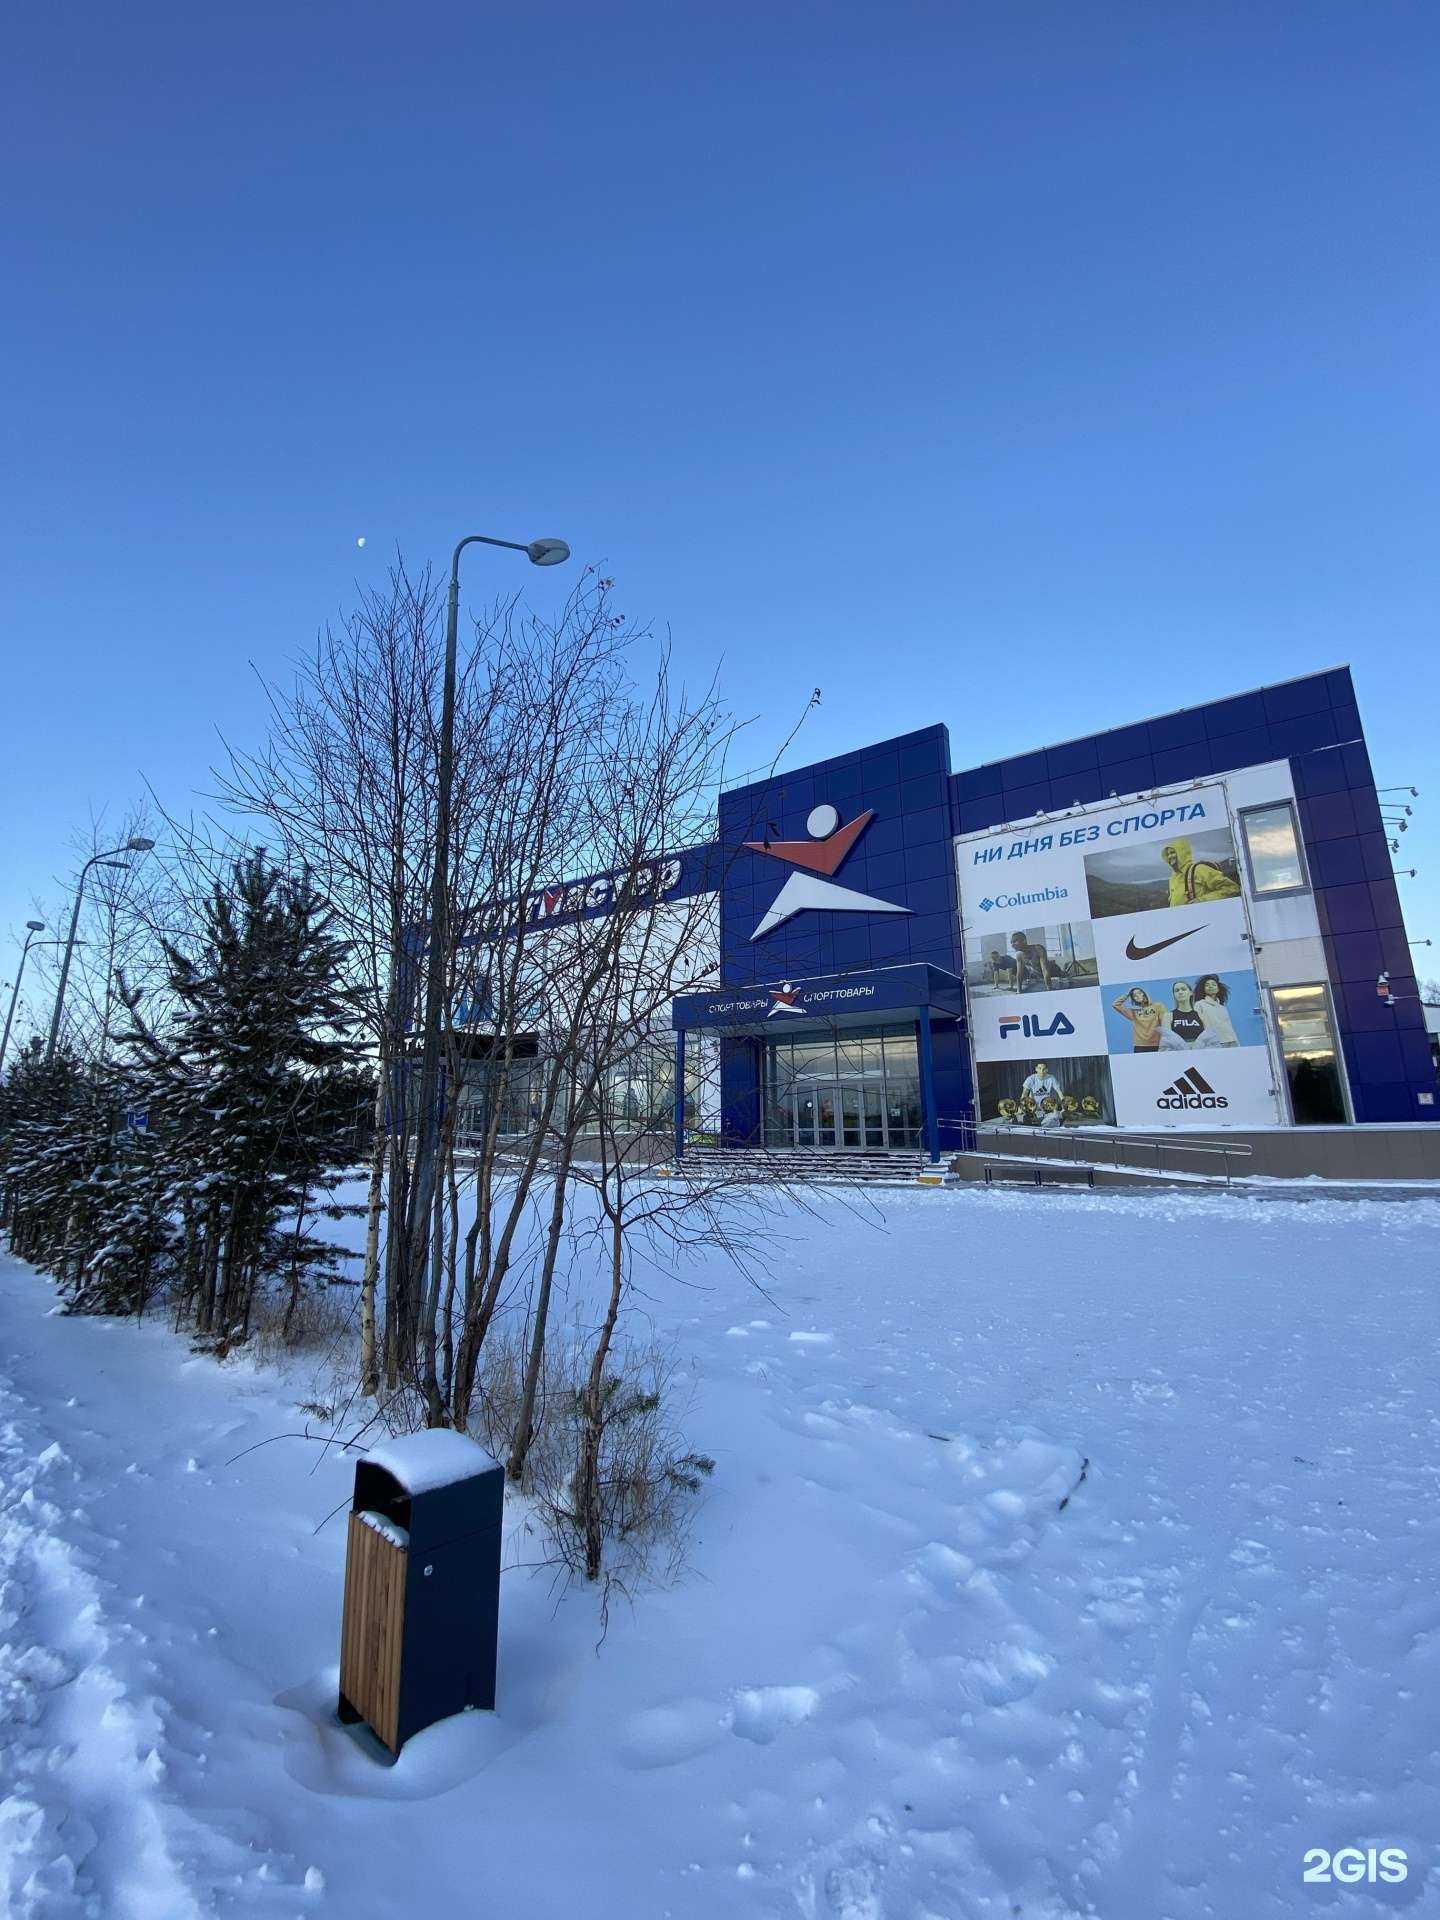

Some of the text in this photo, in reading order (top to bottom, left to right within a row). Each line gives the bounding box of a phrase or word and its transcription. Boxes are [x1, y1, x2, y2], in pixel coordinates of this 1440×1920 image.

[973, 803, 1206, 865] НИ ДНЯ БЕЗ СПОРТА
[995, 886, 1069, 909] Columbia
[803, 985, 875, 1003] СПОРТТОВАРЫ
[998, 1011, 1075, 1039] FILA
[1173, 1019, 1200, 1028] FILA
[1156, 1093, 1229, 1109] adidas
